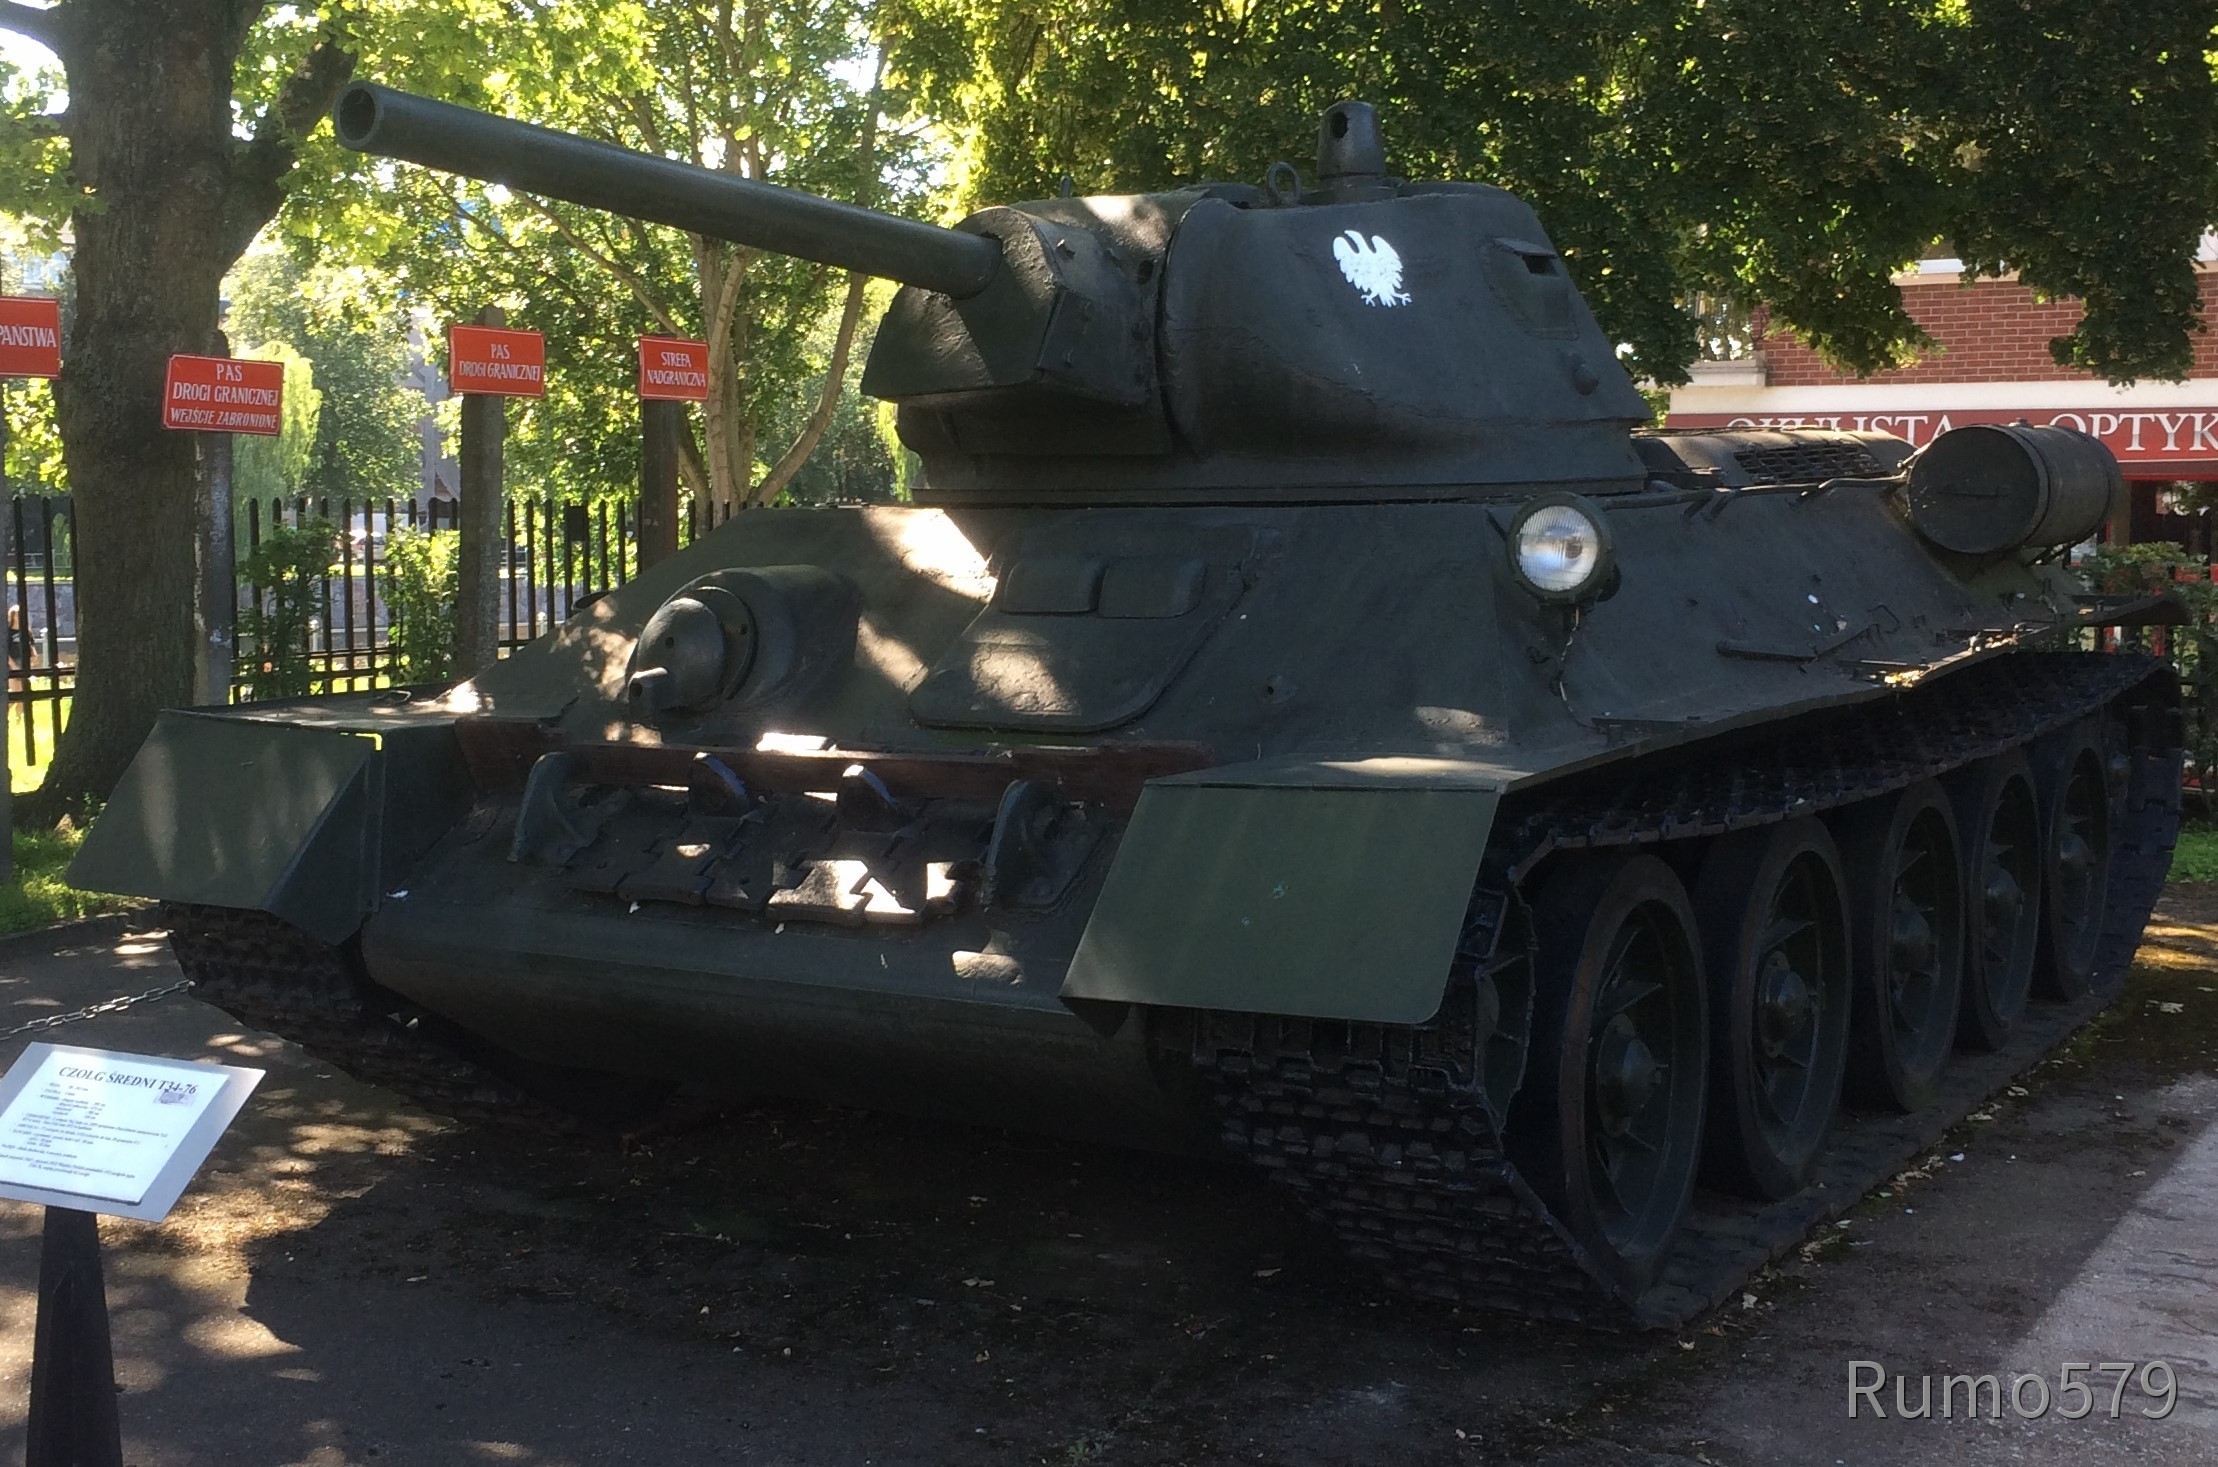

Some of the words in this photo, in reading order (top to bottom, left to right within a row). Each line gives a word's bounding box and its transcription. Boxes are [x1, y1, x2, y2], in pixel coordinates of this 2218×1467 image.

[490, 343, 510, 359] PAS
[661, 351, 692, 368] STREFA
[216, 363, 243, 382] PAS
[459, 361, 486, 377] DROGI
[487, 362, 541, 382] GRANICZNEJ
[647, 369, 706, 387] NADGRANICZNA
[173, 382, 211, 401] DROGI
[214, 385, 279, 407] GRANICZNEJ
[170, 407, 216, 425] WEJŚCIE
[216, 411, 277, 429] ZABRONIONE
[106, 1069, 158, 1089] ŚREDNI
[158, 1079, 199, 1096] T34-76
